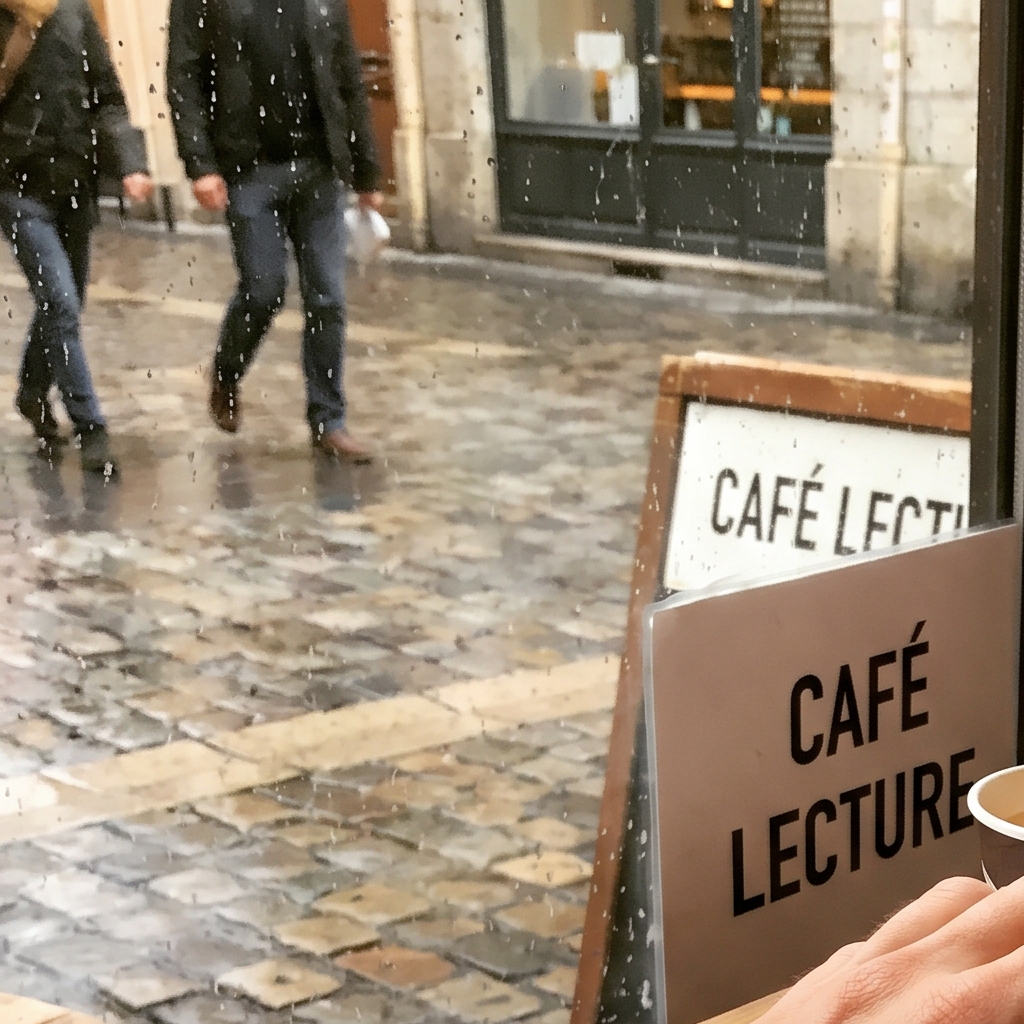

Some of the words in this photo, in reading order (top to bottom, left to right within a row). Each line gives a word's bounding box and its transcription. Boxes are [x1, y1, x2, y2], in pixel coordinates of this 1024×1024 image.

[711, 463, 824, 551] CAFÉ
[789, 620, 930, 766] CAFÉ
[731, 748, 975, 917] LECTURE
